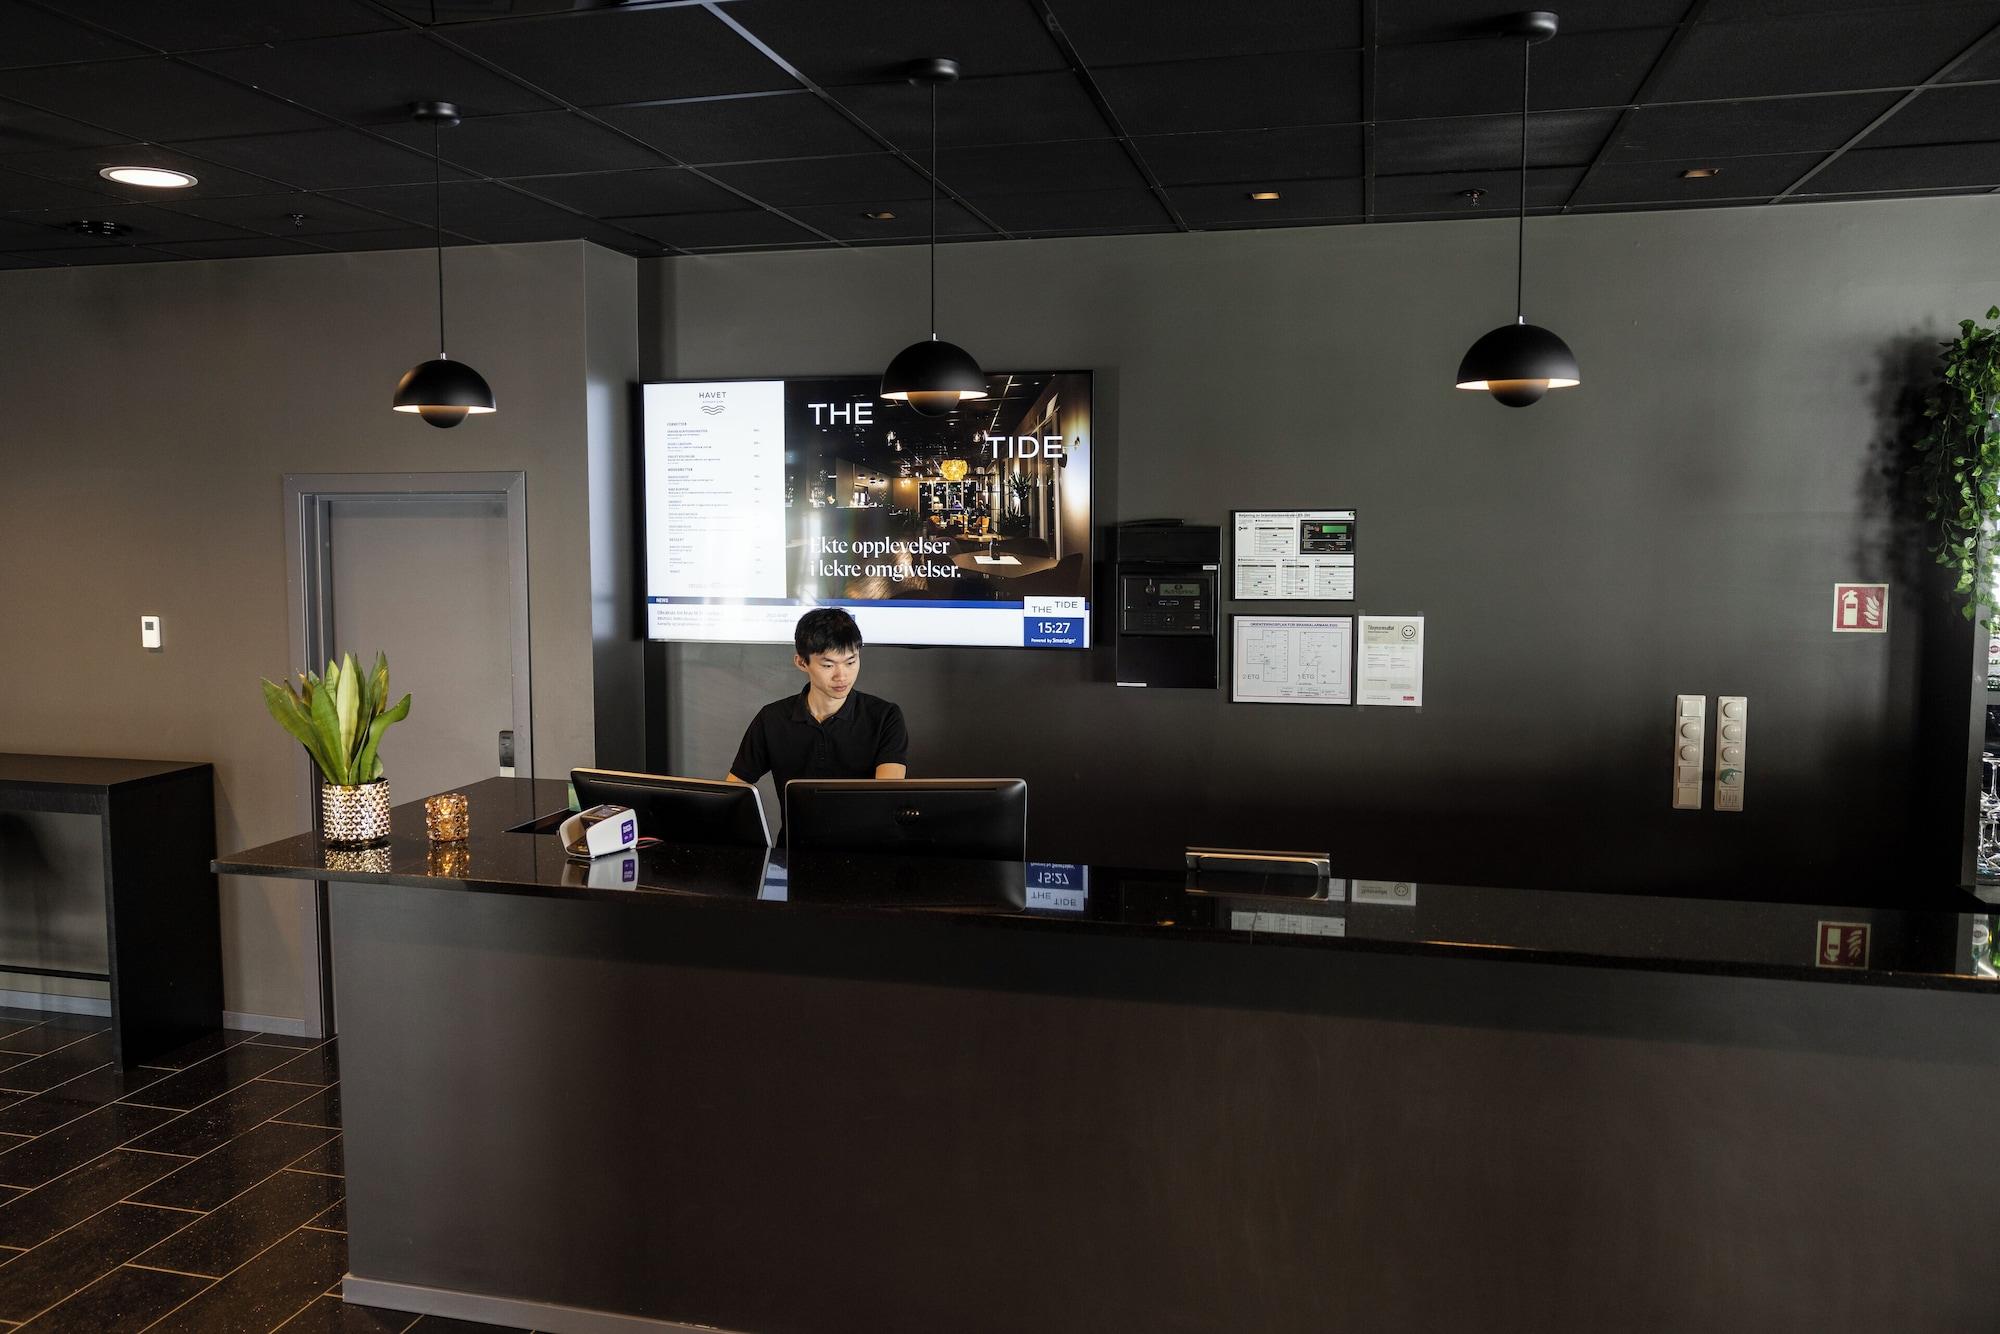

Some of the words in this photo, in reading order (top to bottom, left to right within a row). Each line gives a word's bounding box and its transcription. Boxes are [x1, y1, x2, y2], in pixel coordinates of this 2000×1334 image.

[698, 391, 727, 399] HAVET
[807, 402, 874, 426] THE
[986, 435, 1063, 459] TIDE
[810, 536, 849, 554] Ekte
[851, 536, 951, 559] opplevelser
[810, 560, 815, 577] i
[819, 559, 862, 577] lekre
[864, 559, 962, 582] omgivelser.
[1038, 622, 1071, 634] 15:27
